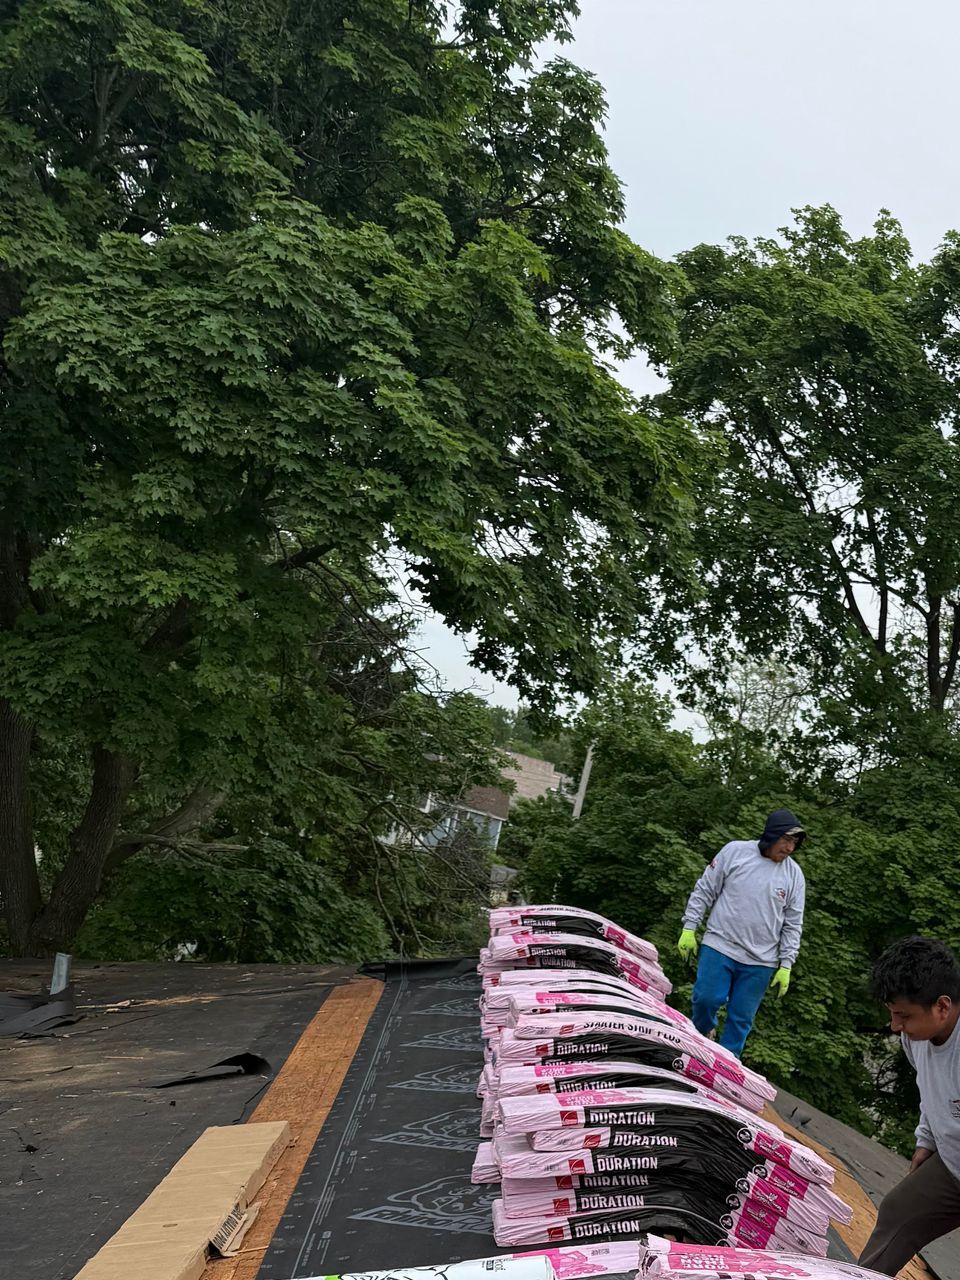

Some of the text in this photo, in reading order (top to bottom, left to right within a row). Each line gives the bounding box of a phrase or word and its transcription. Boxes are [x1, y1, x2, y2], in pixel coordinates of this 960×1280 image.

[557, 1044, 608, 1054] DURATION
[590, 1112, 655, 1125] DURATION
[613, 1135, 678, 1147] DURATION
[597, 1157, 658, 1171] DURATION
[581, 1195, 644, 1209] DURATION
[575, 1221, 640, 1236] DURATION
